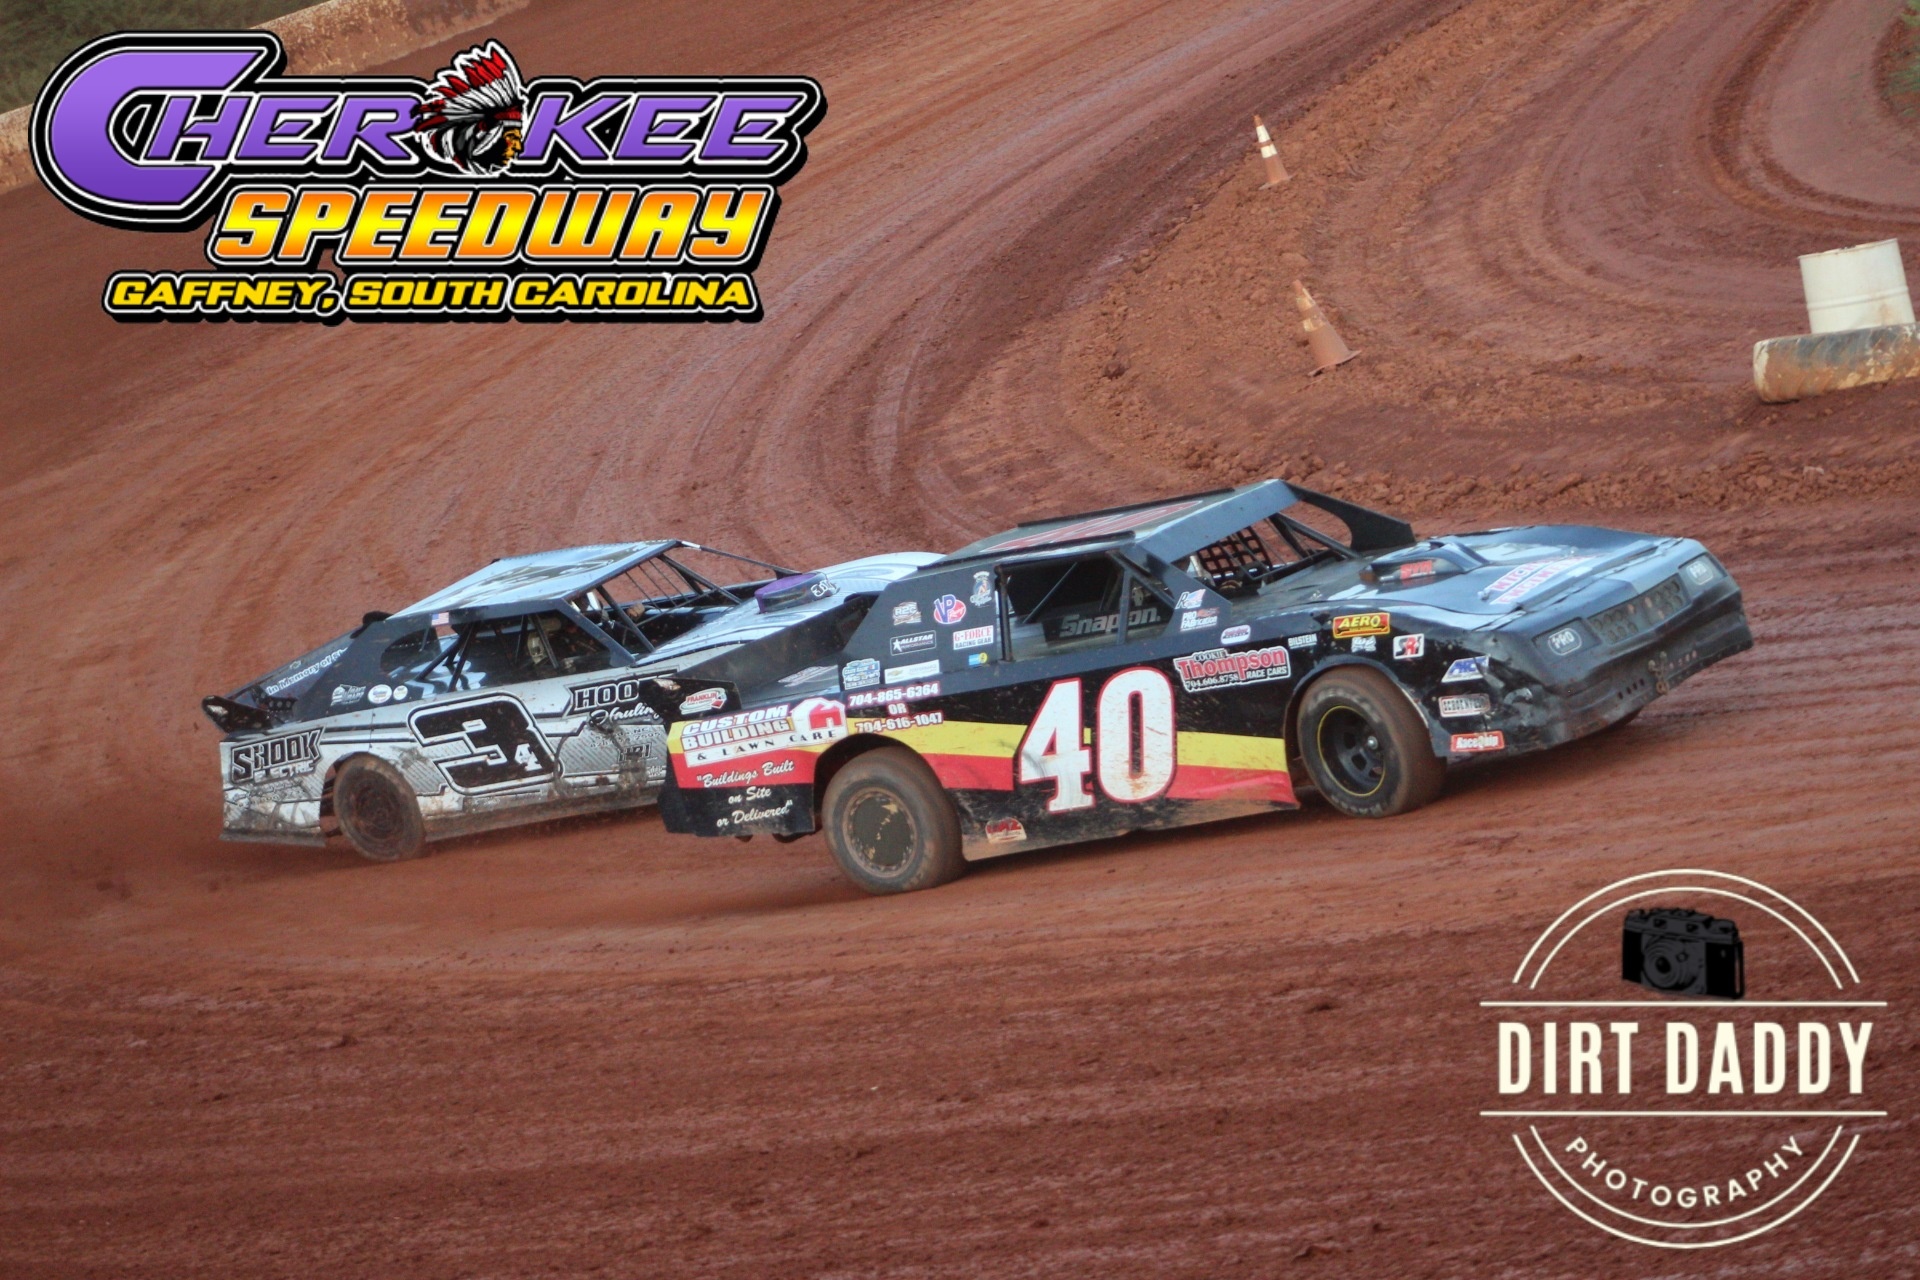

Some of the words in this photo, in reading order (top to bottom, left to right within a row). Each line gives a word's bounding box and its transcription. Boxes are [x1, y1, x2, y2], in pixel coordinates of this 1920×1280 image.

[1338, 615, 1381, 628] AERO
[901, 634, 934, 645] ALLSTAR
[954, 627, 991, 642] G-FORCE
[1288, 634, 1318, 646] BILSTEIN
[1551, 630, 1575, 649] PRO
[1177, 648, 1286, 680] Thompson
[1194, 650, 1227, 662] COOKIE
[266, 684, 280, 696] In
[279, 662, 320, 690] Memory
[1246, 669, 1266, 679] RACE
[1266, 666, 1288, 677] CARS
[574, 679, 641, 711] HOO
[687, 691, 719, 703] FRANKLIN
[849, 682, 939, 706] 704-865-6364
[888, 703, 908, 715] OR
[682, 704, 789, 737] CUSTOM
[856, 712, 943, 733] 704-616-1047
[680, 718, 791, 751] BUILDING
[1018, 665, 1176, 814] 40
[697, 752, 707, 761] &
[722, 738, 775, 756] LAWN
[789, 730, 838, 743] CARE
[231, 729, 322, 783] SHOOK
[254, 760, 314, 784] EECTRIC
[762, 760, 795, 776] Built
[728, 794, 742, 805] on
[746, 786, 772, 801] Site
[716, 816, 729, 828] or
